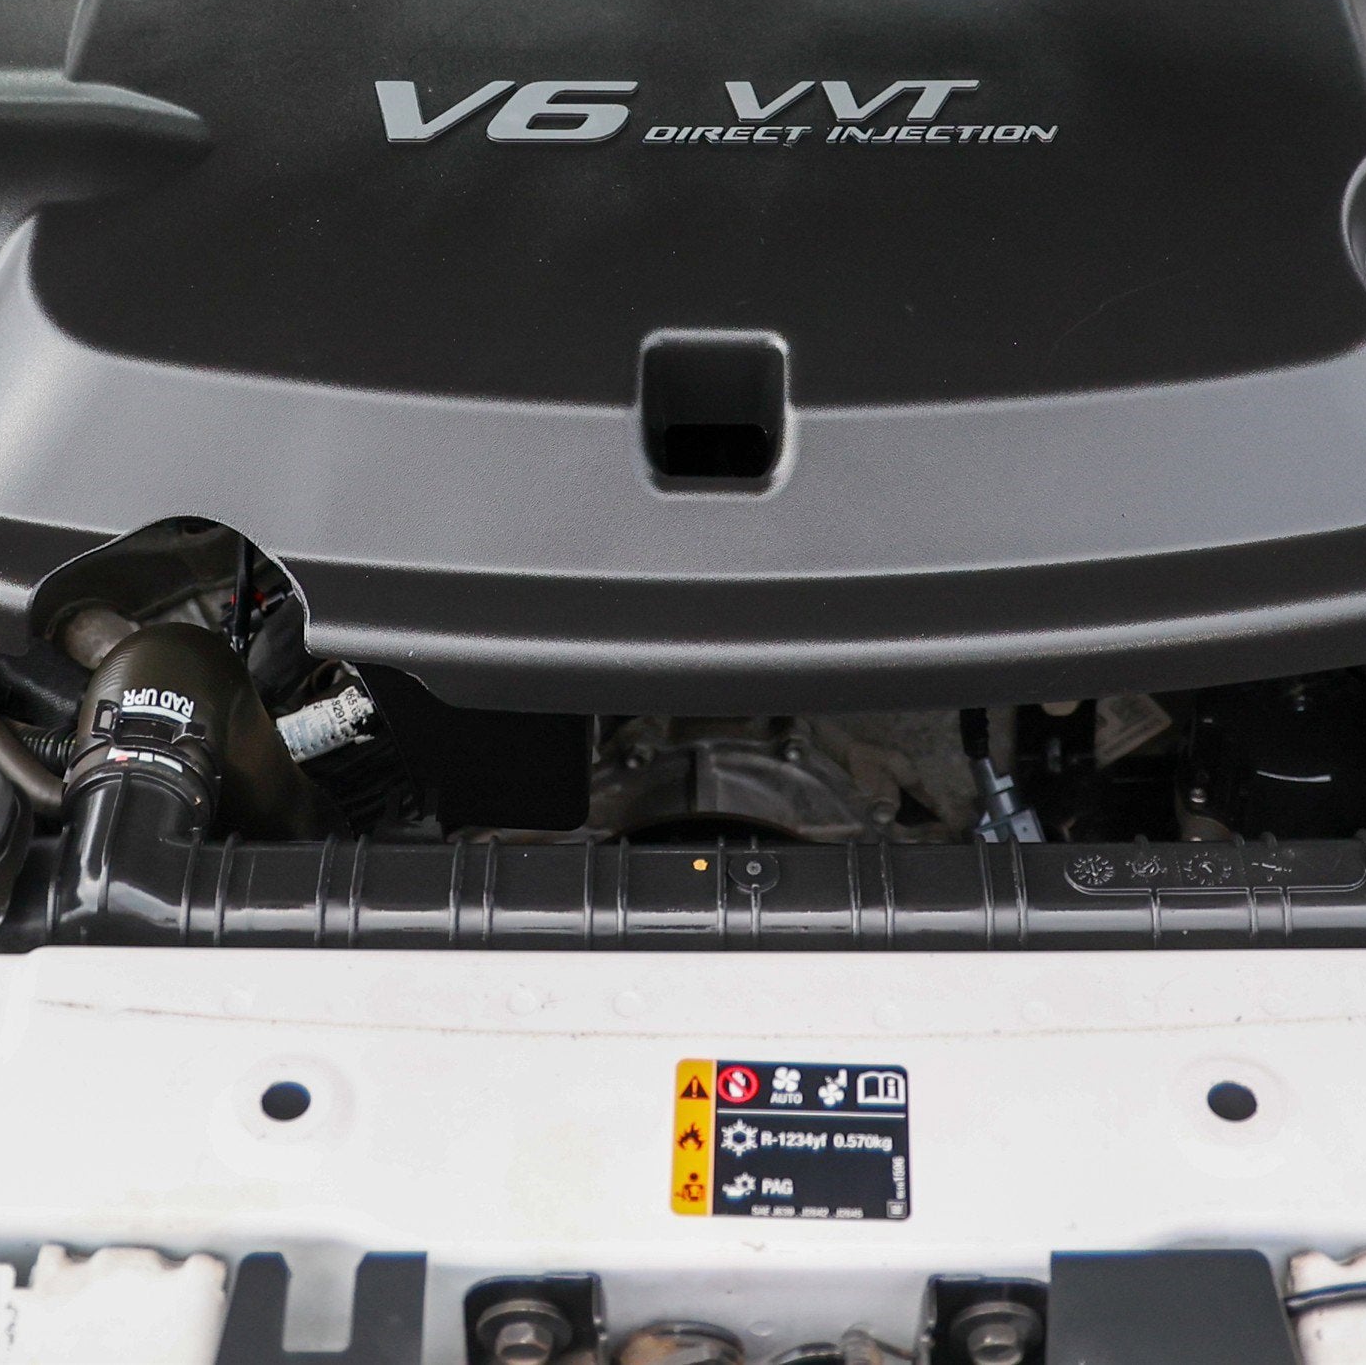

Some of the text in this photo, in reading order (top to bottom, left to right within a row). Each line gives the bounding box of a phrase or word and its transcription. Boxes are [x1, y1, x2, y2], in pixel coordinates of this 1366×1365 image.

[374, 79, 981, 143] V6 VVT
[641, 124, 1060, 145] DIRECT INJECTION
[122, 688, 194, 717] RAD UPR
[770, 1093, 803, 1105] AUTO
[760, 1131, 893, 1152] R-1234yf 0.570kg
[761, 1178, 794, 1196] PAG
